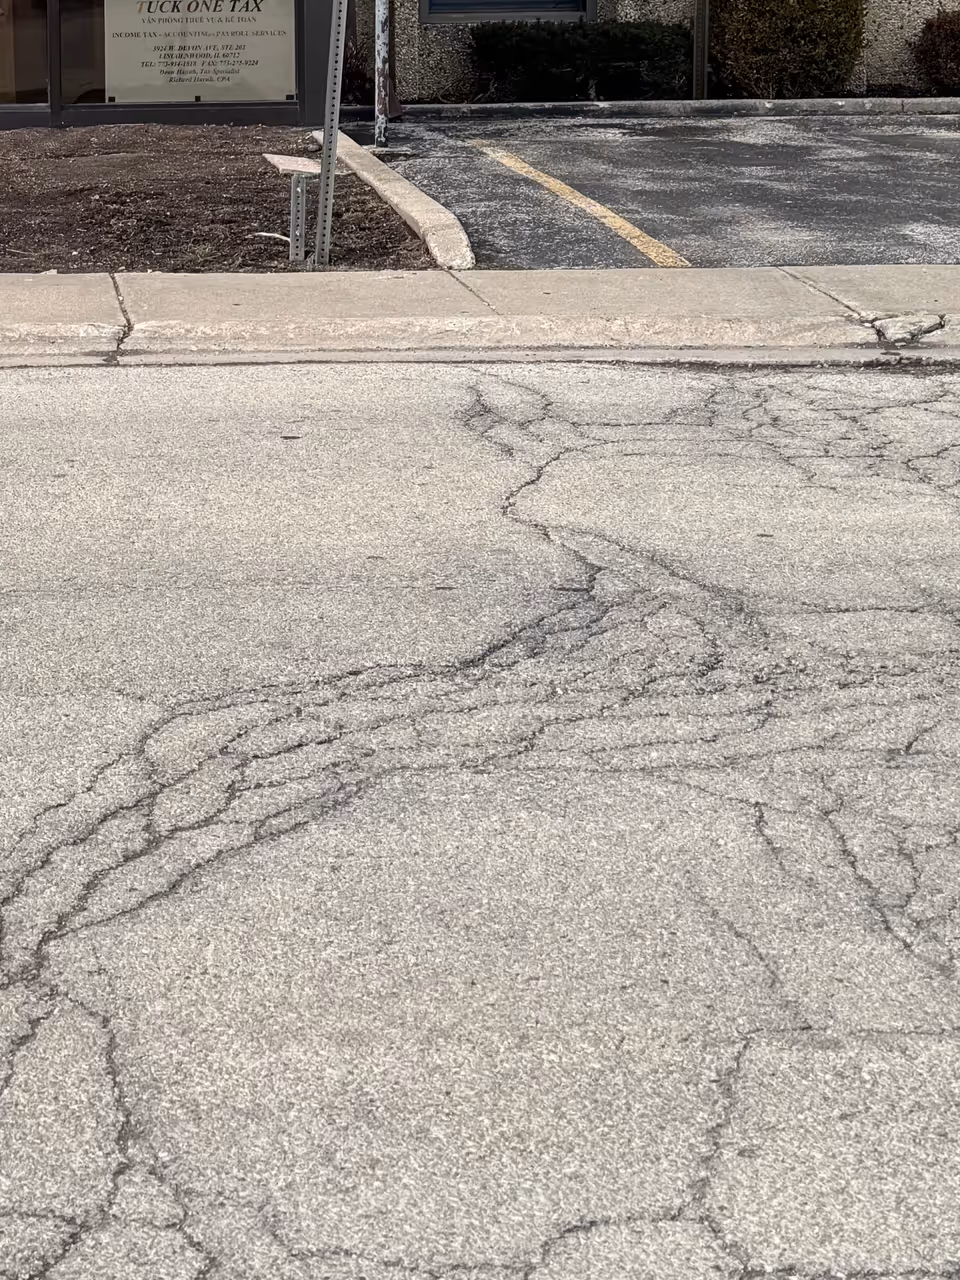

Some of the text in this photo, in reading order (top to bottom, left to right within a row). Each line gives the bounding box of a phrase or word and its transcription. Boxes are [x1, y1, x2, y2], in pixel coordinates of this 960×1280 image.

[136, 0, 264, 13] TUCK ONE TAX
